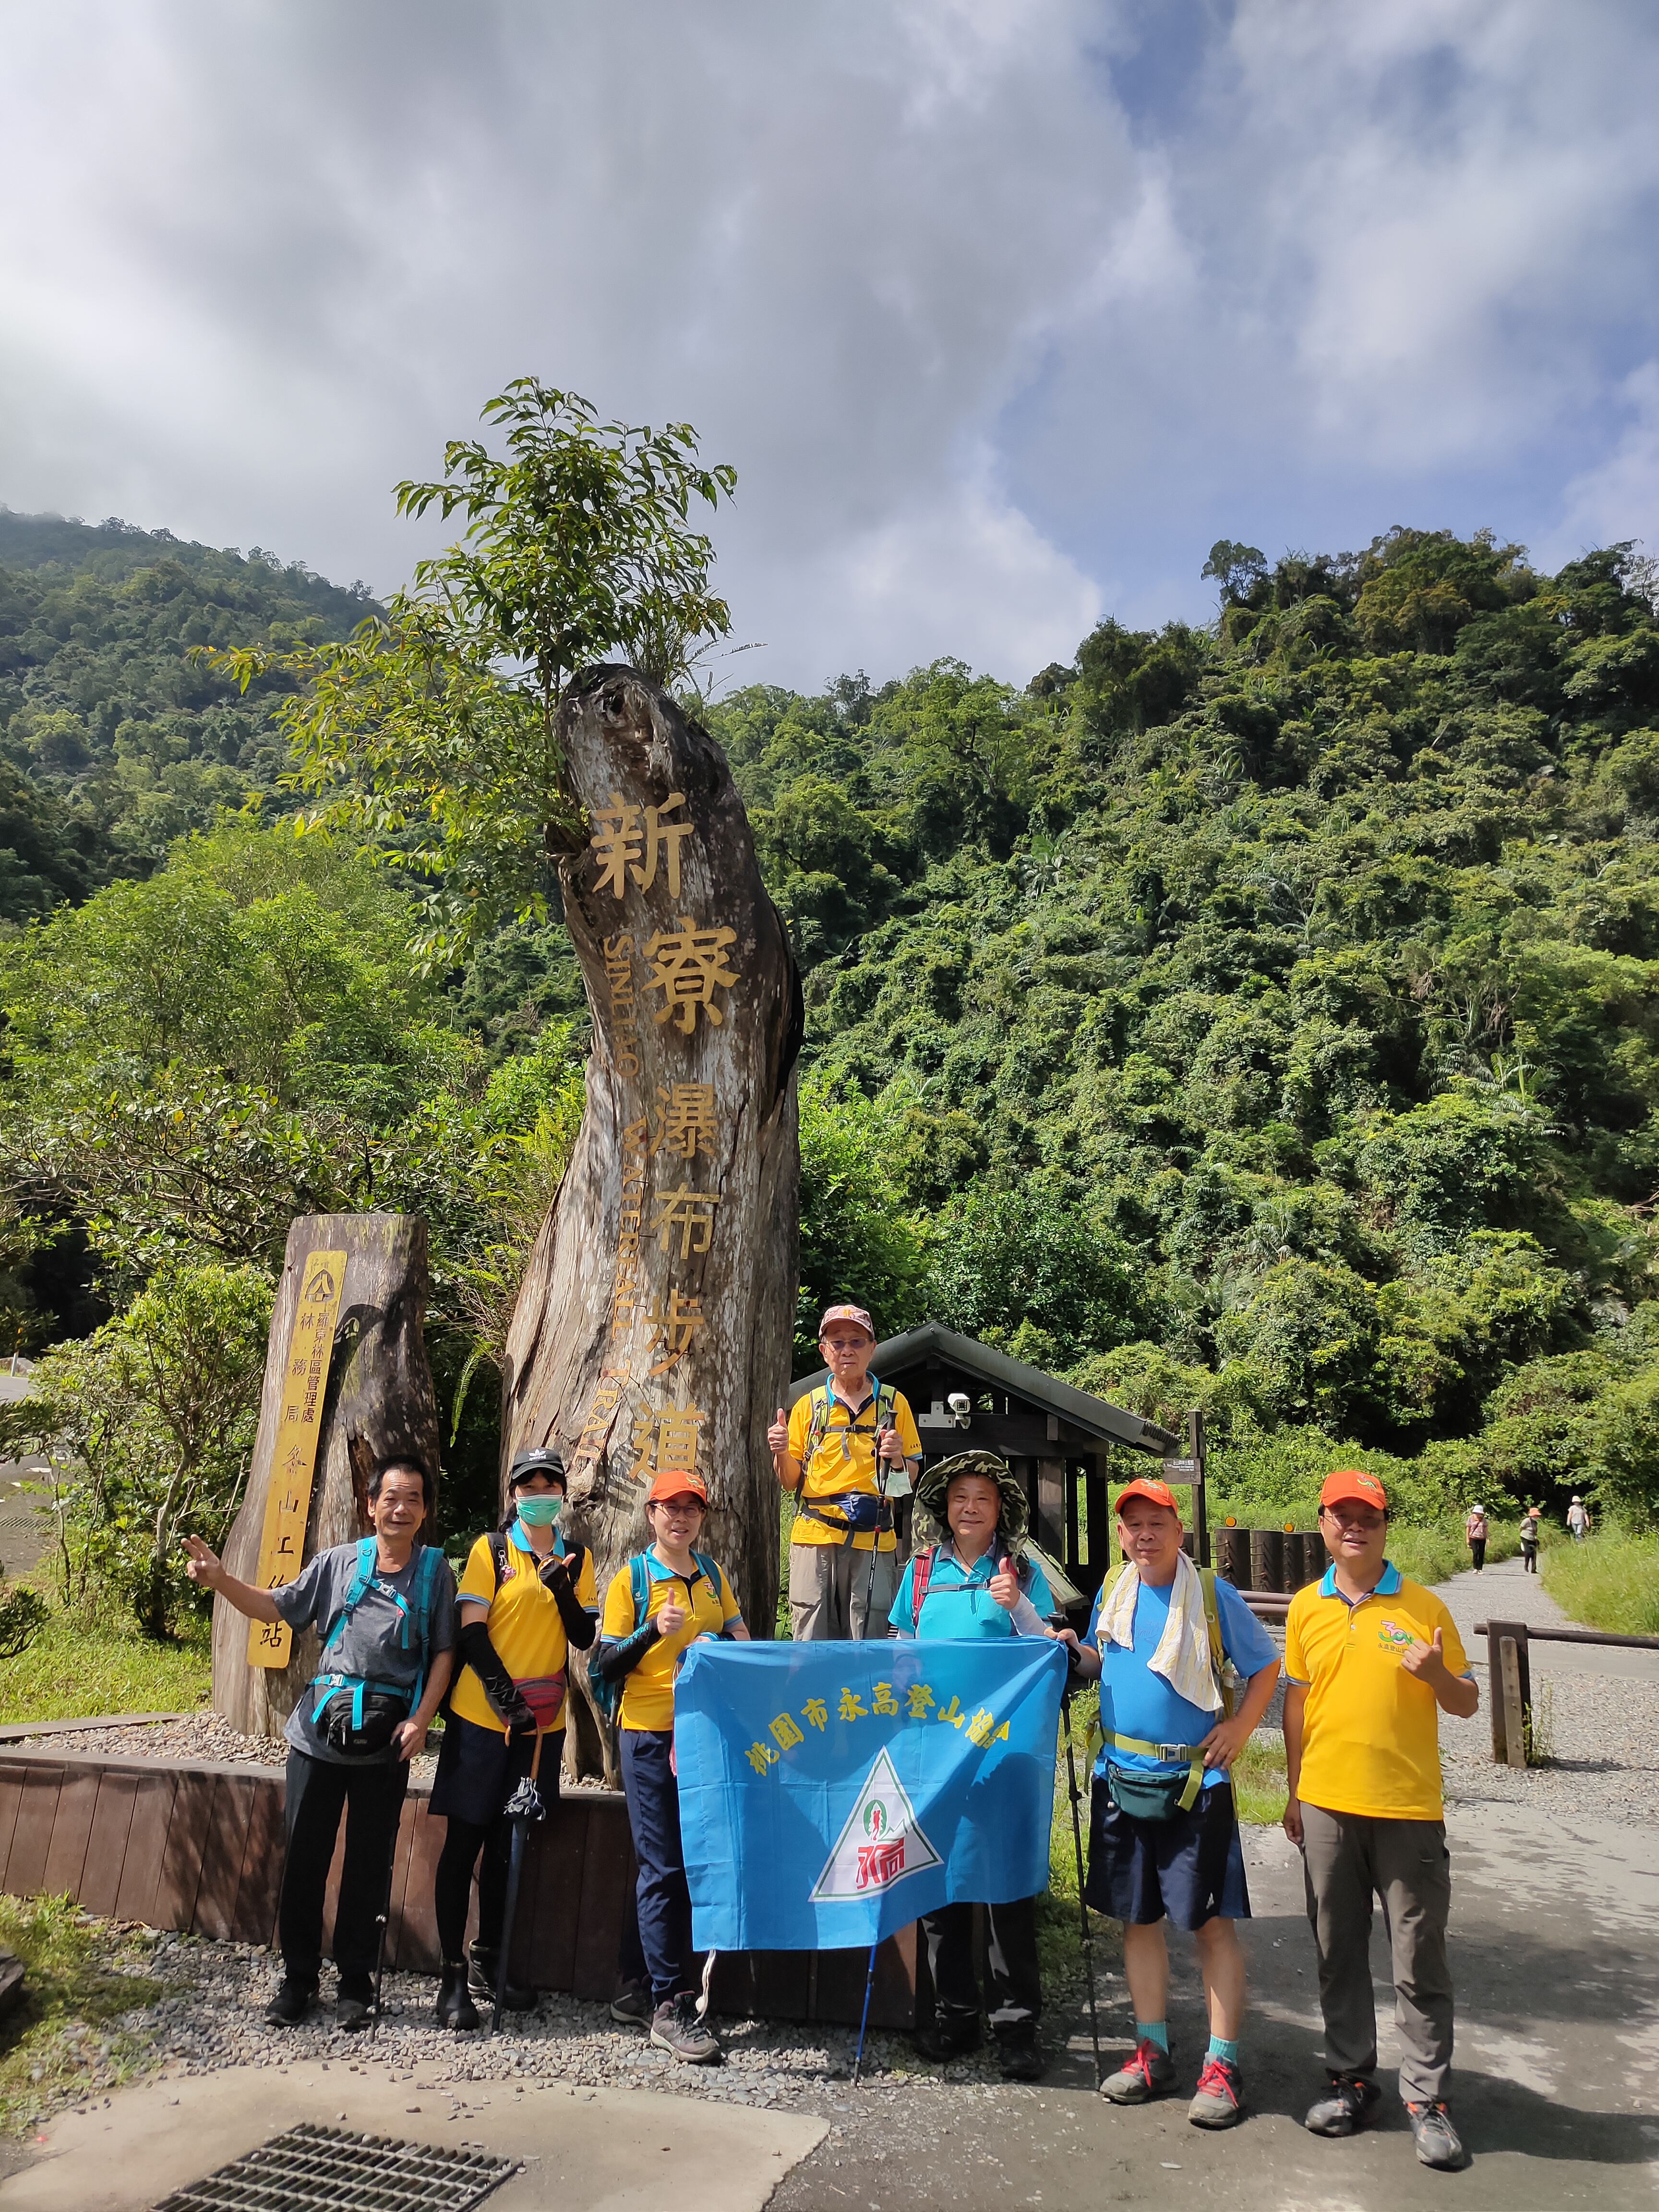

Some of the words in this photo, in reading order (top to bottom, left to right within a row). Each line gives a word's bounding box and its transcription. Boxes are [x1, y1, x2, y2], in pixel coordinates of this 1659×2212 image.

[603, 934, 639, 1077] SINLIAO
[590, 792, 741, 1480] 新寮瀑布步道
[612, 1115, 648, 1339] WATERFALL
[284, 1312, 315, 1423] 林務局
[301, 1312, 330, 1423] 羅東林區管理處
[571, 1358, 631, 1467] TRAIL
